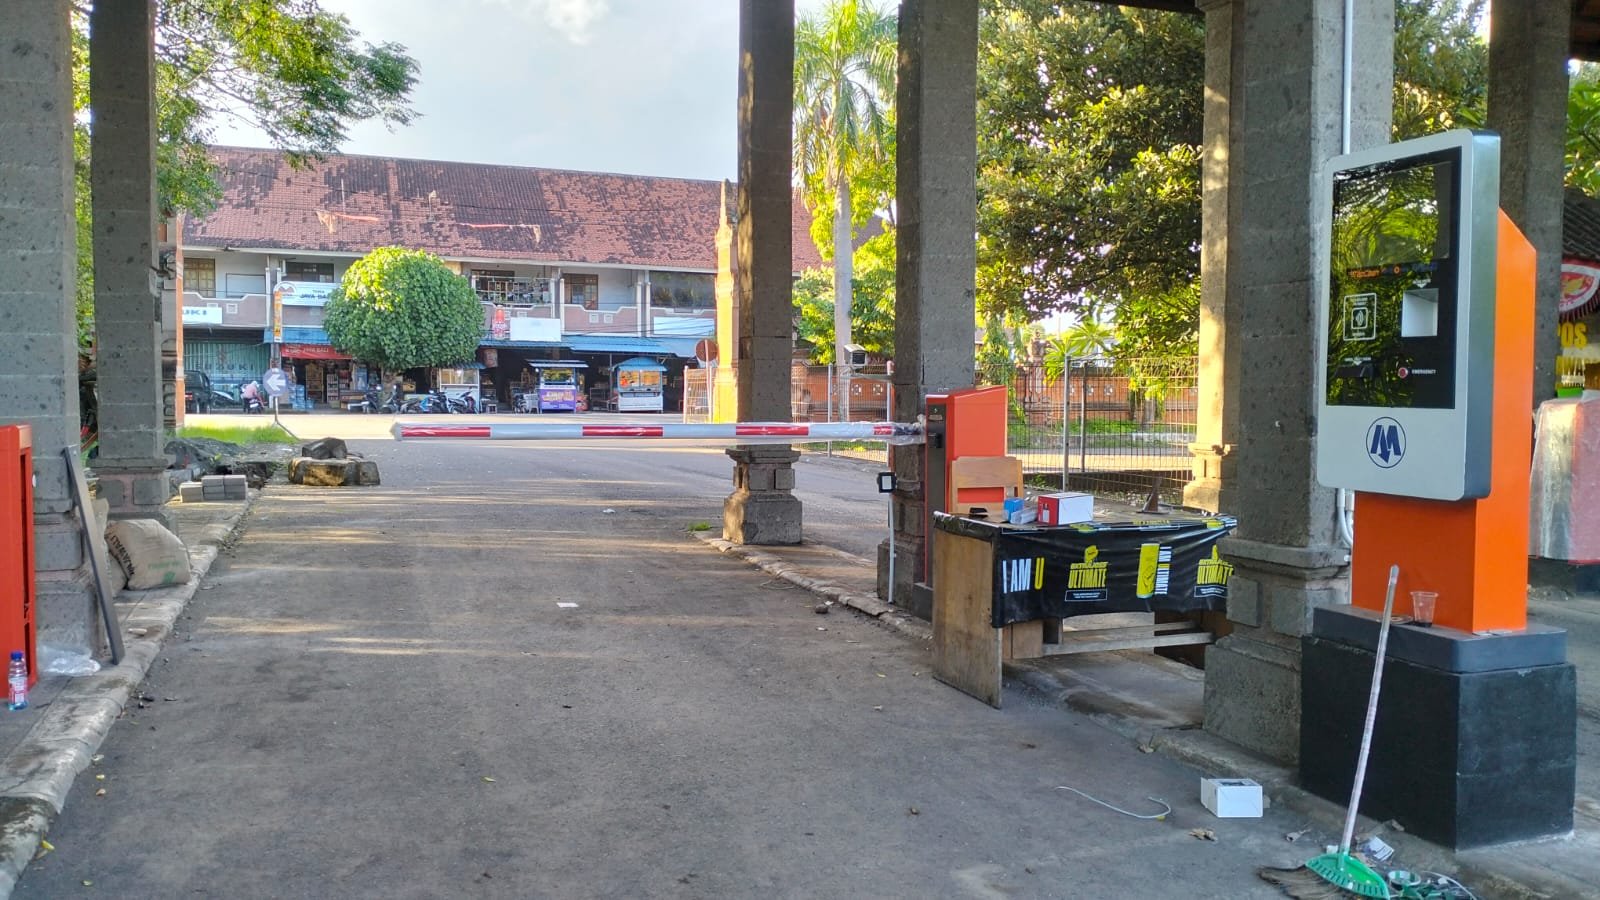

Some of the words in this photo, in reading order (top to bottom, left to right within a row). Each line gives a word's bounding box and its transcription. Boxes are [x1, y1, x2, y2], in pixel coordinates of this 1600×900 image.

[1010, 558, 1031, 593] AM
[1034, 557, 1045, 590] U
[1068, 568, 1108, 589] ULTIMATE
